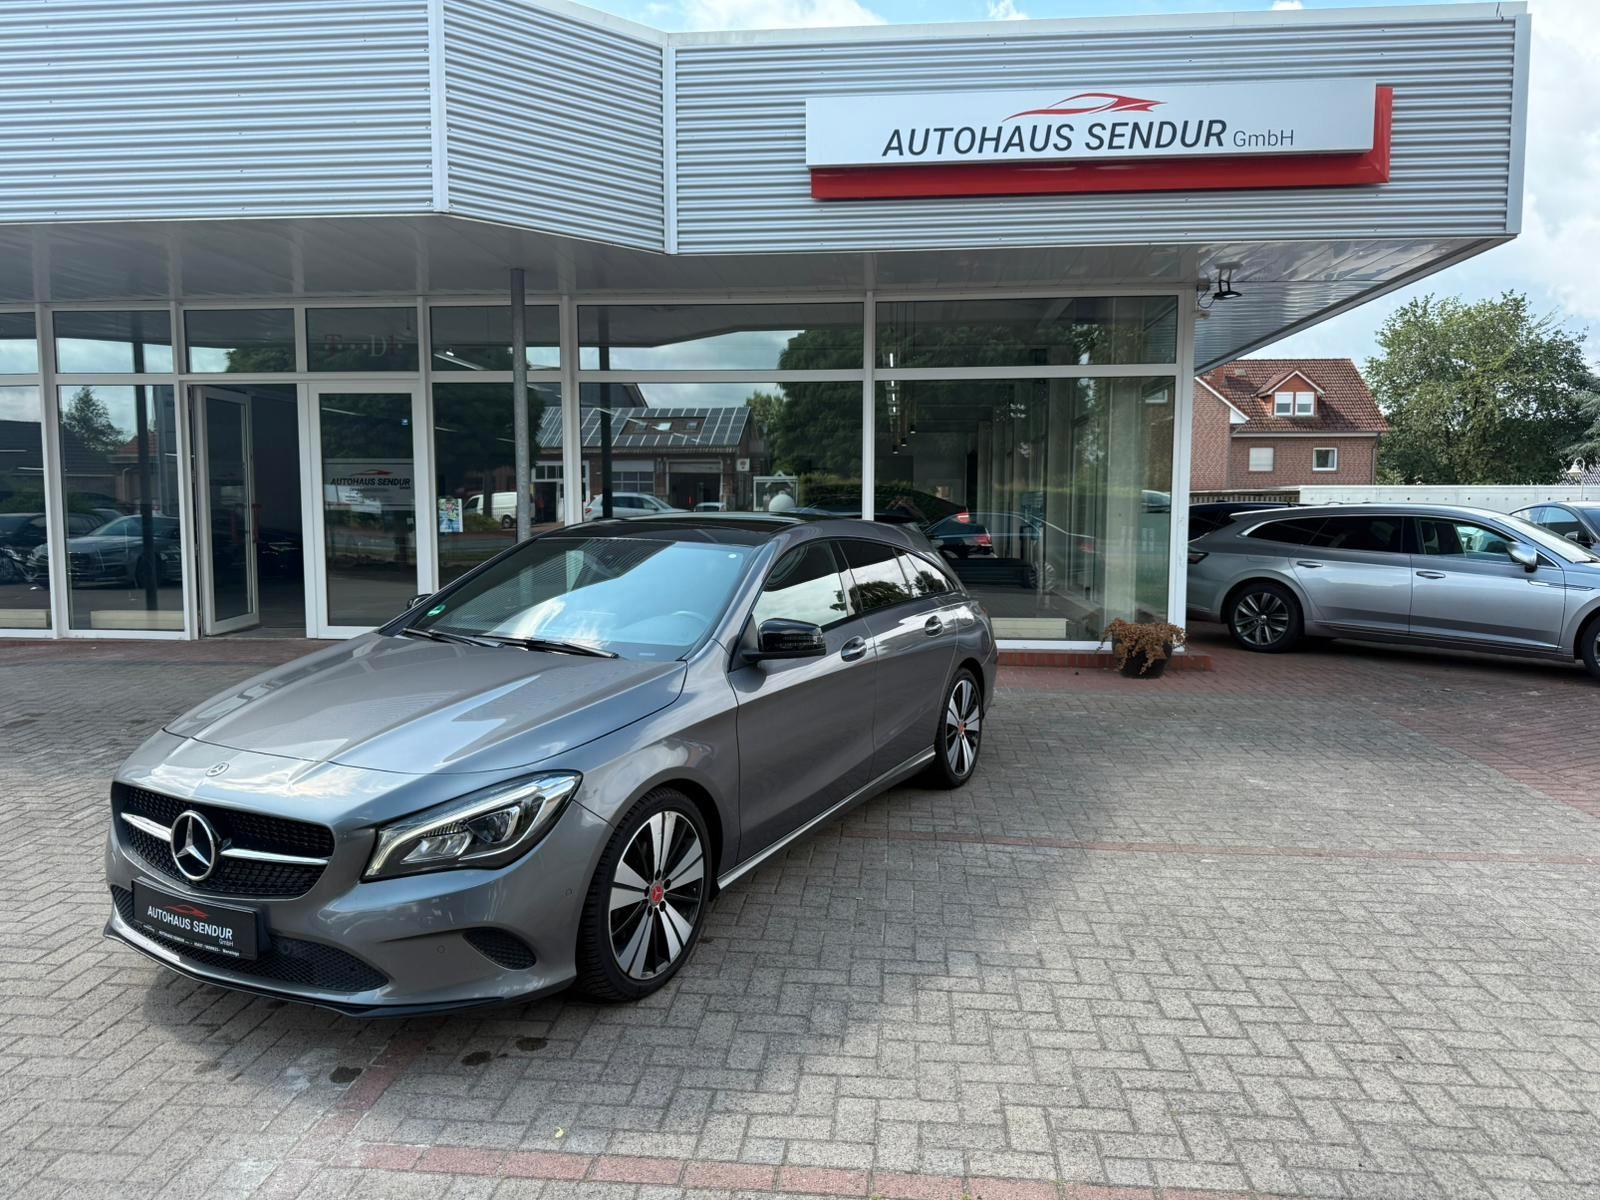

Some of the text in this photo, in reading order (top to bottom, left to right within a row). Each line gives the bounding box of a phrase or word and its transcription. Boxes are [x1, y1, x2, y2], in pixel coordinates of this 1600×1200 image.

[882, 119, 1295, 157] AUTOHAUS SENDUR GmbH
[330, 478, 411, 487] AUTOHAUS SENDUR
[147, 905, 191, 930] AUTOHAUS
[193, 920, 233, 940] SENDUR
[218, 938, 234, 948] GmbH
